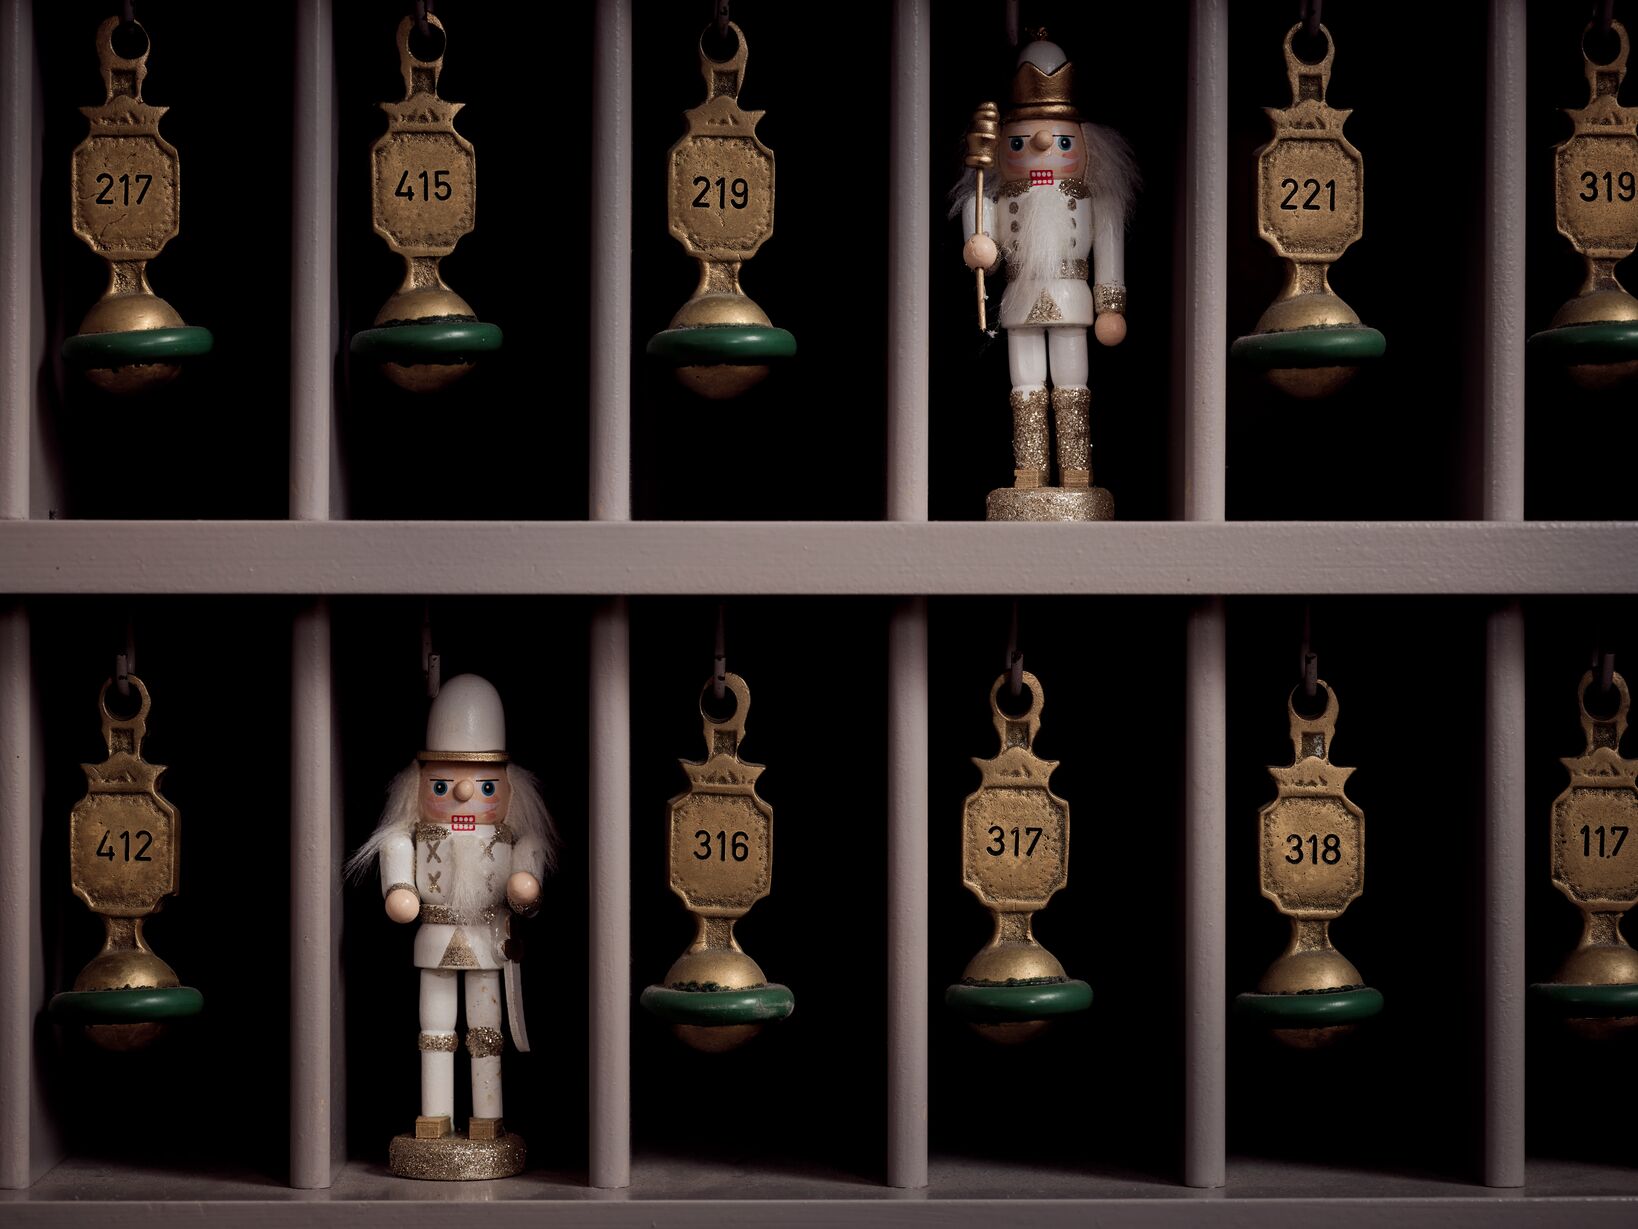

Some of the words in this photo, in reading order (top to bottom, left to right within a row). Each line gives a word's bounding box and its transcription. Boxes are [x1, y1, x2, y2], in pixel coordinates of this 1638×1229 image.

[95, 173, 153, 206] 217
[394, 170, 452, 201] 415
[691, 176, 749, 209] 219
[1280, 178, 1336, 211] 221
[1579, 171, 1636, 202] 319
[96, 830, 153, 861] 412
[693, 830, 749, 861] 316
[986, 825, 1043, 857] 317
[1285, 834, 1342, 865] 318
[1580, 825, 1629, 857] 117
